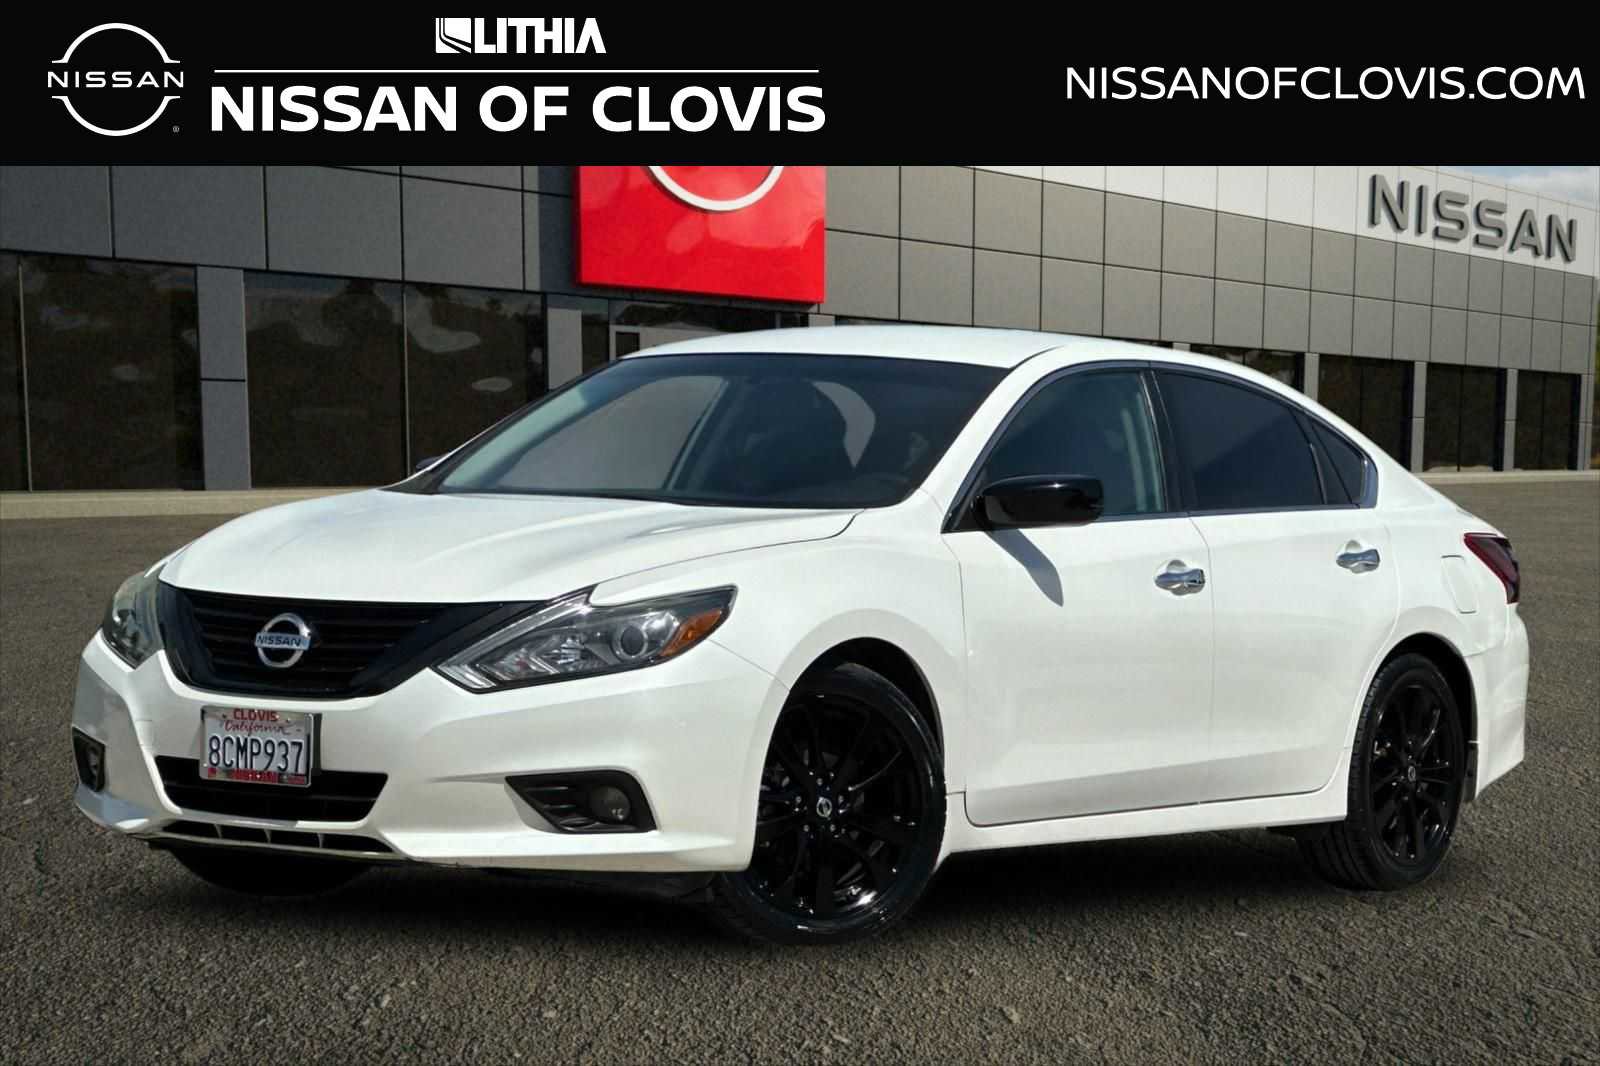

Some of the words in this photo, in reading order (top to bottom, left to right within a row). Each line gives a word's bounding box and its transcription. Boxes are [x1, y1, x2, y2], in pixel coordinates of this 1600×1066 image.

[1368, 174, 1577, 263] NISSAN
[256, 634, 302, 647] NISSAN
[233, 708, 279, 721] CLOVIS
[224, 720, 290, 736] California
[209, 735, 303, 773] 8CMP937
